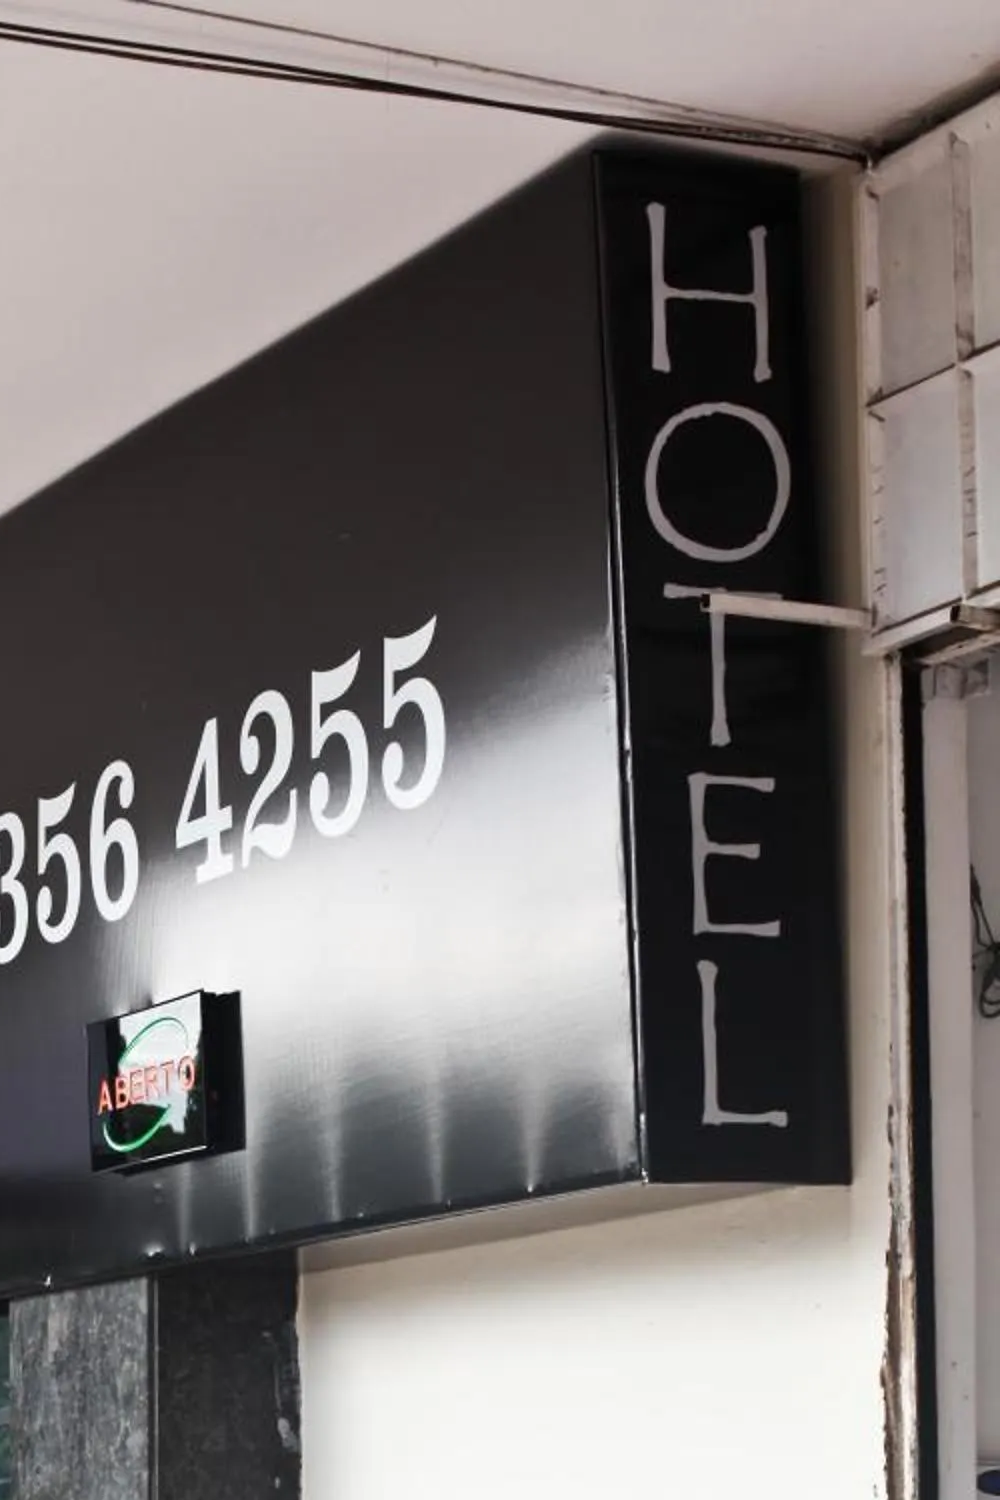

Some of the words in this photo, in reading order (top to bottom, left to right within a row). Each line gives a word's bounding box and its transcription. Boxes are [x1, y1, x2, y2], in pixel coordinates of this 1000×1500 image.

[175, 614, 446, 883] 4255
[645, 202, 791, 1128] HOTEL
[97, 1055, 196, 1116] ABERTO
